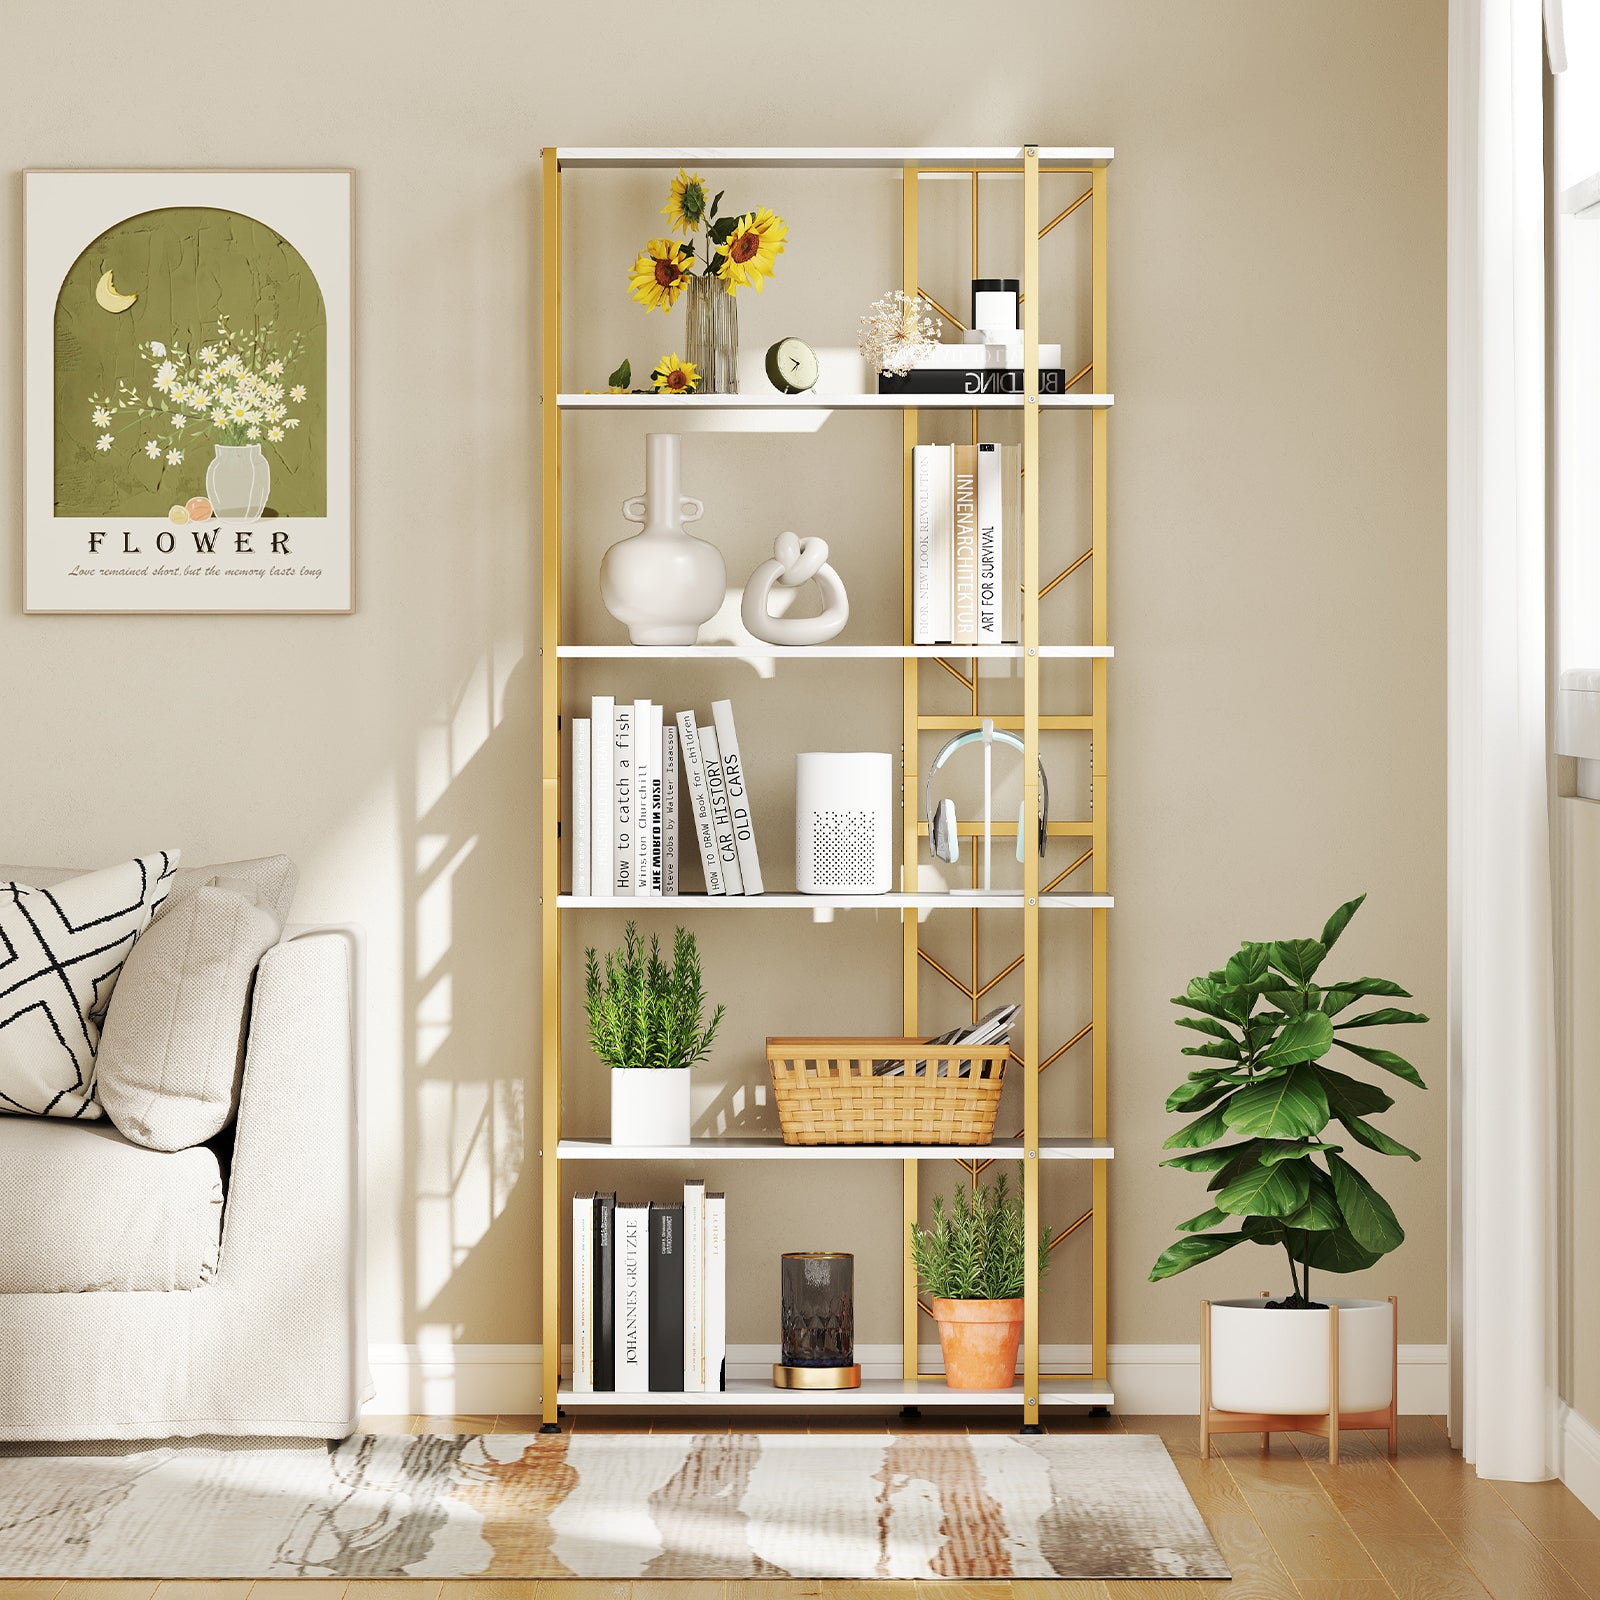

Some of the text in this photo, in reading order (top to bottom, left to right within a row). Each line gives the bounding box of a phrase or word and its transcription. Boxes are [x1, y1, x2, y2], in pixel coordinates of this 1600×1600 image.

[88, 527, 292, 555] FLOWER
[919, 456, 929, 532] REVOLUTION
[68, 565, 95, 576] Love
[100, 565, 148, 576] remained
[205, 566, 221, 576] the
[225, 568, 265, 578] memory
[269, 565, 295, 576] lasts
[300, 566, 322, 579] long
[919, 536, 929, 569] LOOK
[919, 571, 929, 599] NEW
[957, 474, 974, 633] INNENARCHITEKTUR
[981, 526, 994, 632] ART FOR SURVIVAL
[616, 713, 629, 888] How to catch a fish
[639, 764, 647, 887] Winston Churchill
[666, 819, 675, 829] by
[683, 715, 720, 890] HOW TO DRAW Book for children
[706, 759, 735, 862] CAR HISTORY
[725, 754, 750, 841] OLD CARS
[624, 1220, 638, 1365] JOHANNES GRÜTZKE
